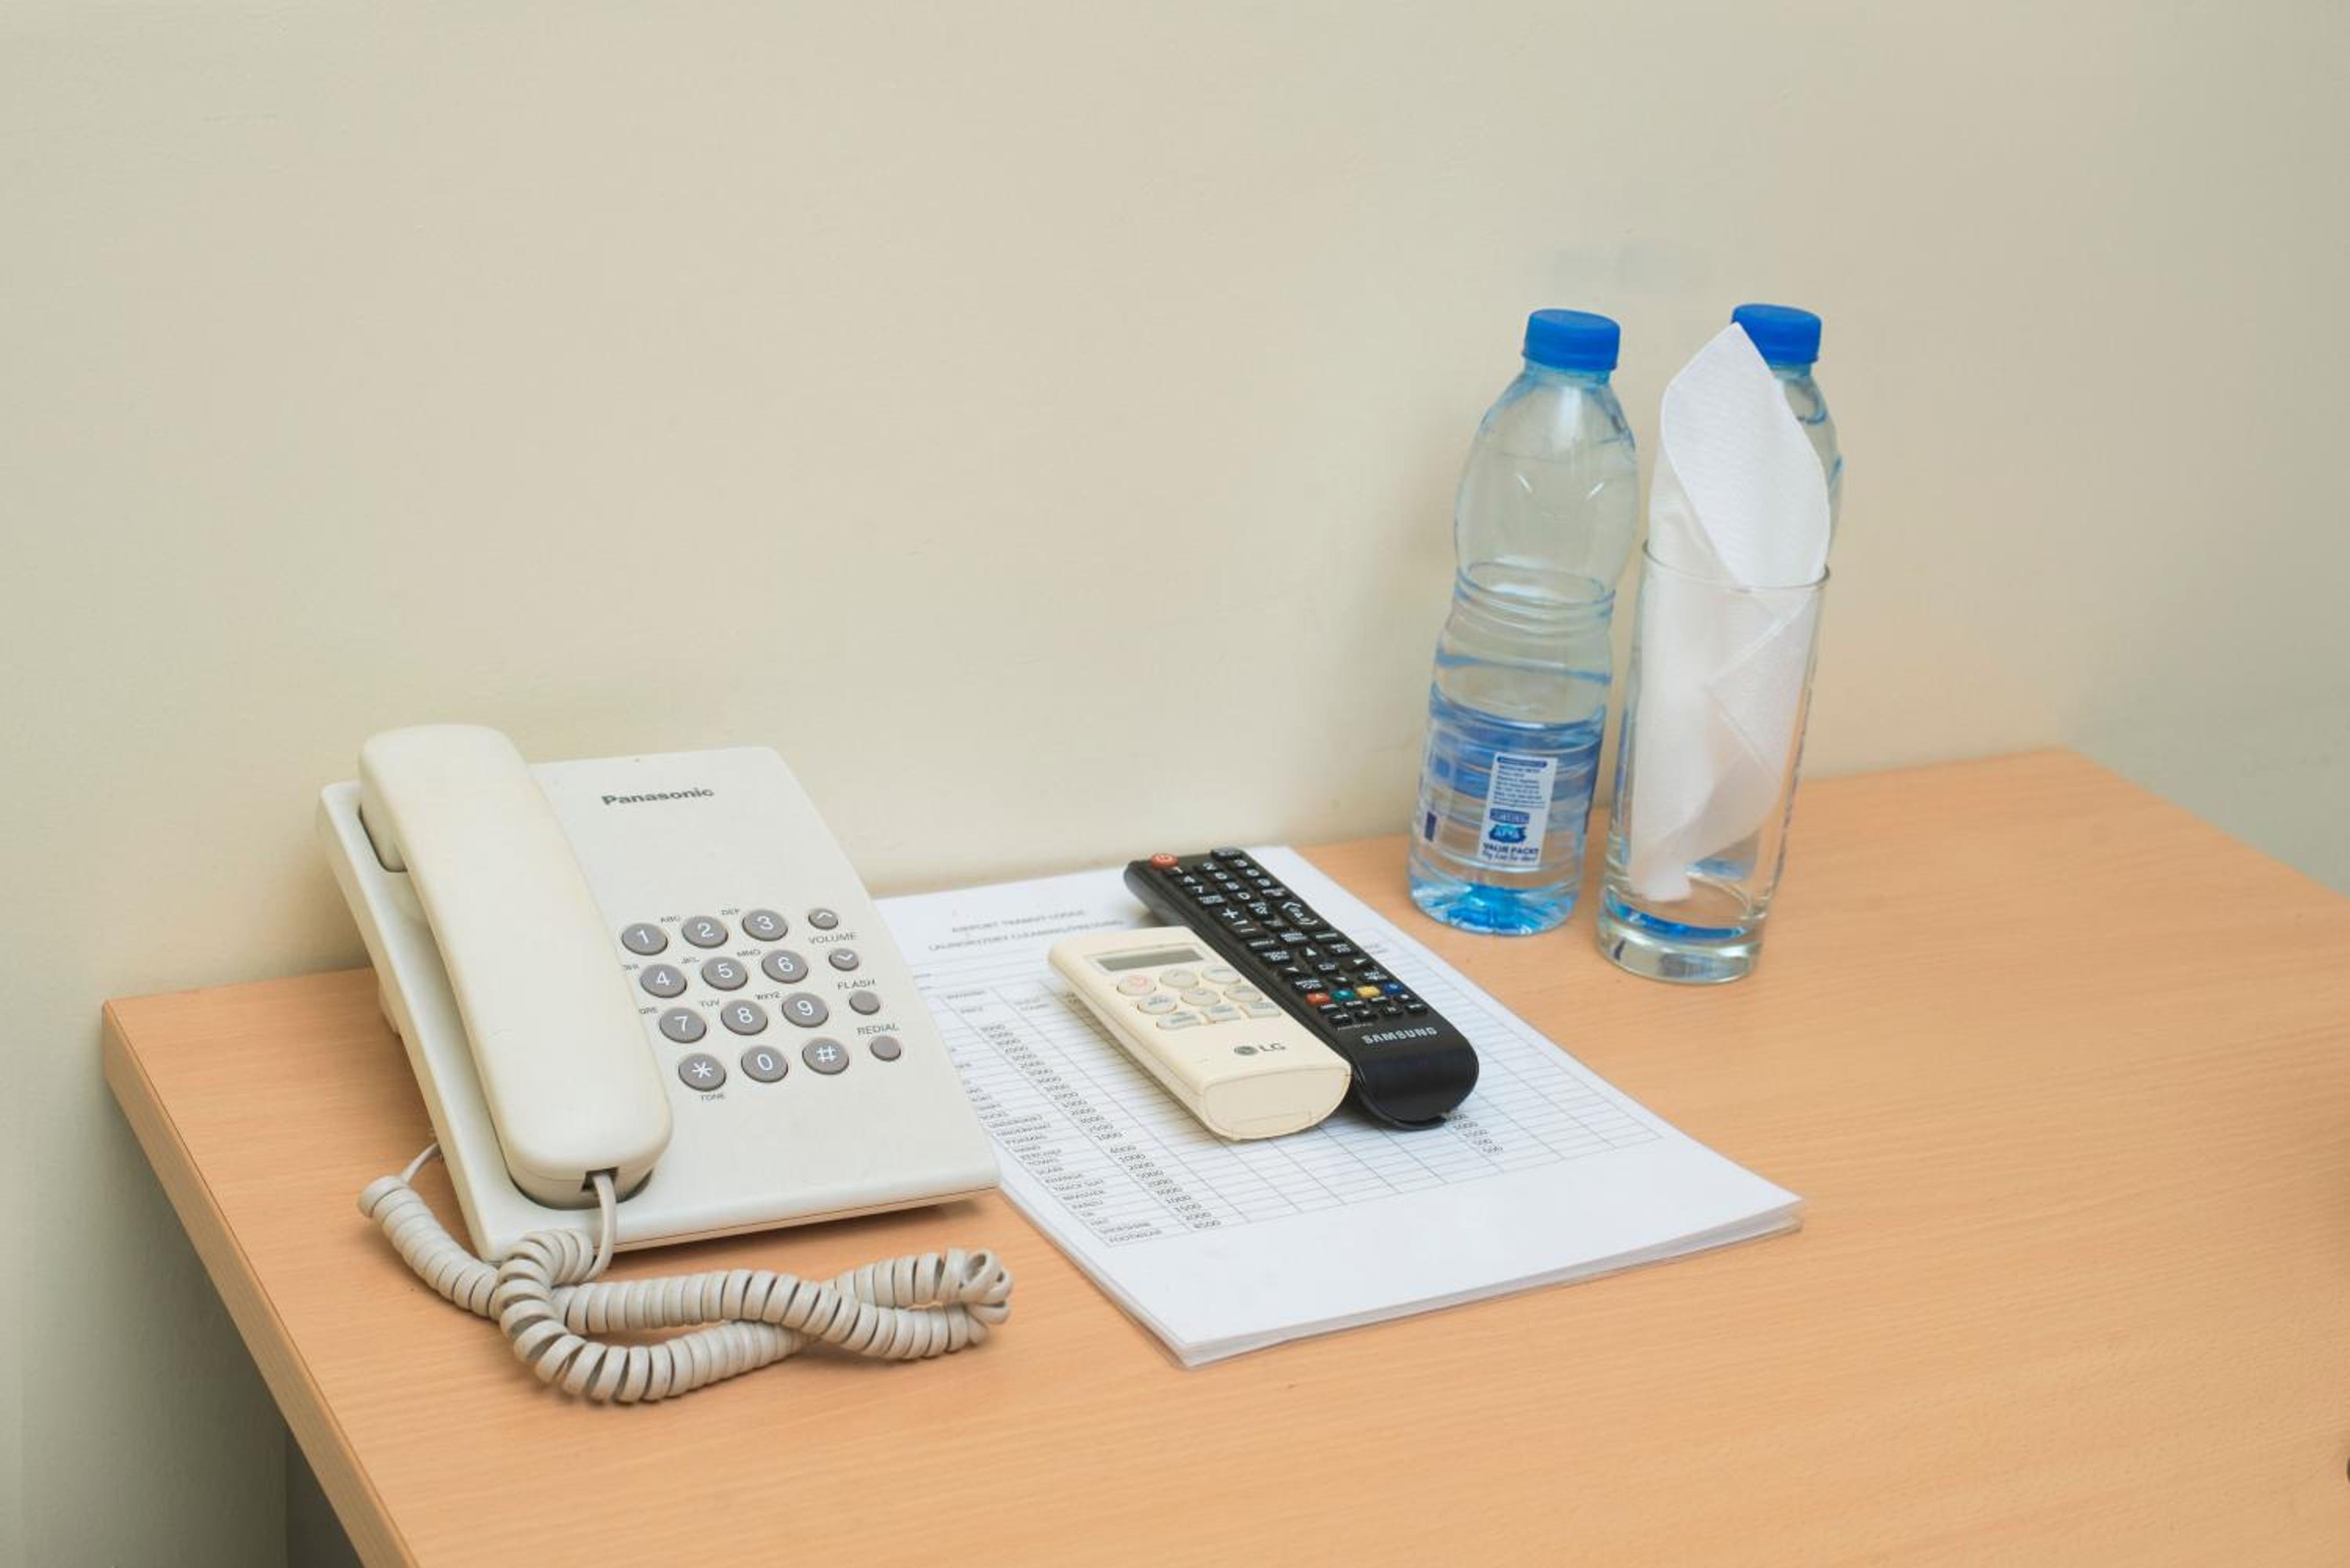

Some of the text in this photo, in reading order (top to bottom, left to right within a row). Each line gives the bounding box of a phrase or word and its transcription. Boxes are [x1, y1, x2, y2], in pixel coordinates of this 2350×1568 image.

[602, 787, 714, 806] Panasonic
[660, 915, 681, 924] ABC
[721, 908, 740, 916] DEF
[700, 922, 714, 939] 2
[757, 915, 773, 931] 3
[637, 929, 650, 945] 1
[808, 933, 859, 945] VOLUME
[736, 948, 761, 958] MNO
[718, 963, 733, 979] 5
[778, 956, 794, 973] 6
[655, 971, 670, 987] 4
[836, 978, 877, 991] FLASH
[700, 999, 720, 1008] TUV
[754, 992, 781, 1001] WXYZ
[738, 1008, 754, 1025] 8
[797, 1001, 813, 1017] 9
[676, 1015, 689, 1032] 7
[856, 1023, 900, 1035] REDIAL
[1361, 1027, 1438, 1045] SAMSUNG
[817, 1046, 837, 1064] #
[1260, 1042, 1286, 1053] LG
[757, 1053, 772, 1071] 0
[701, 1093, 726, 1101] TONE
